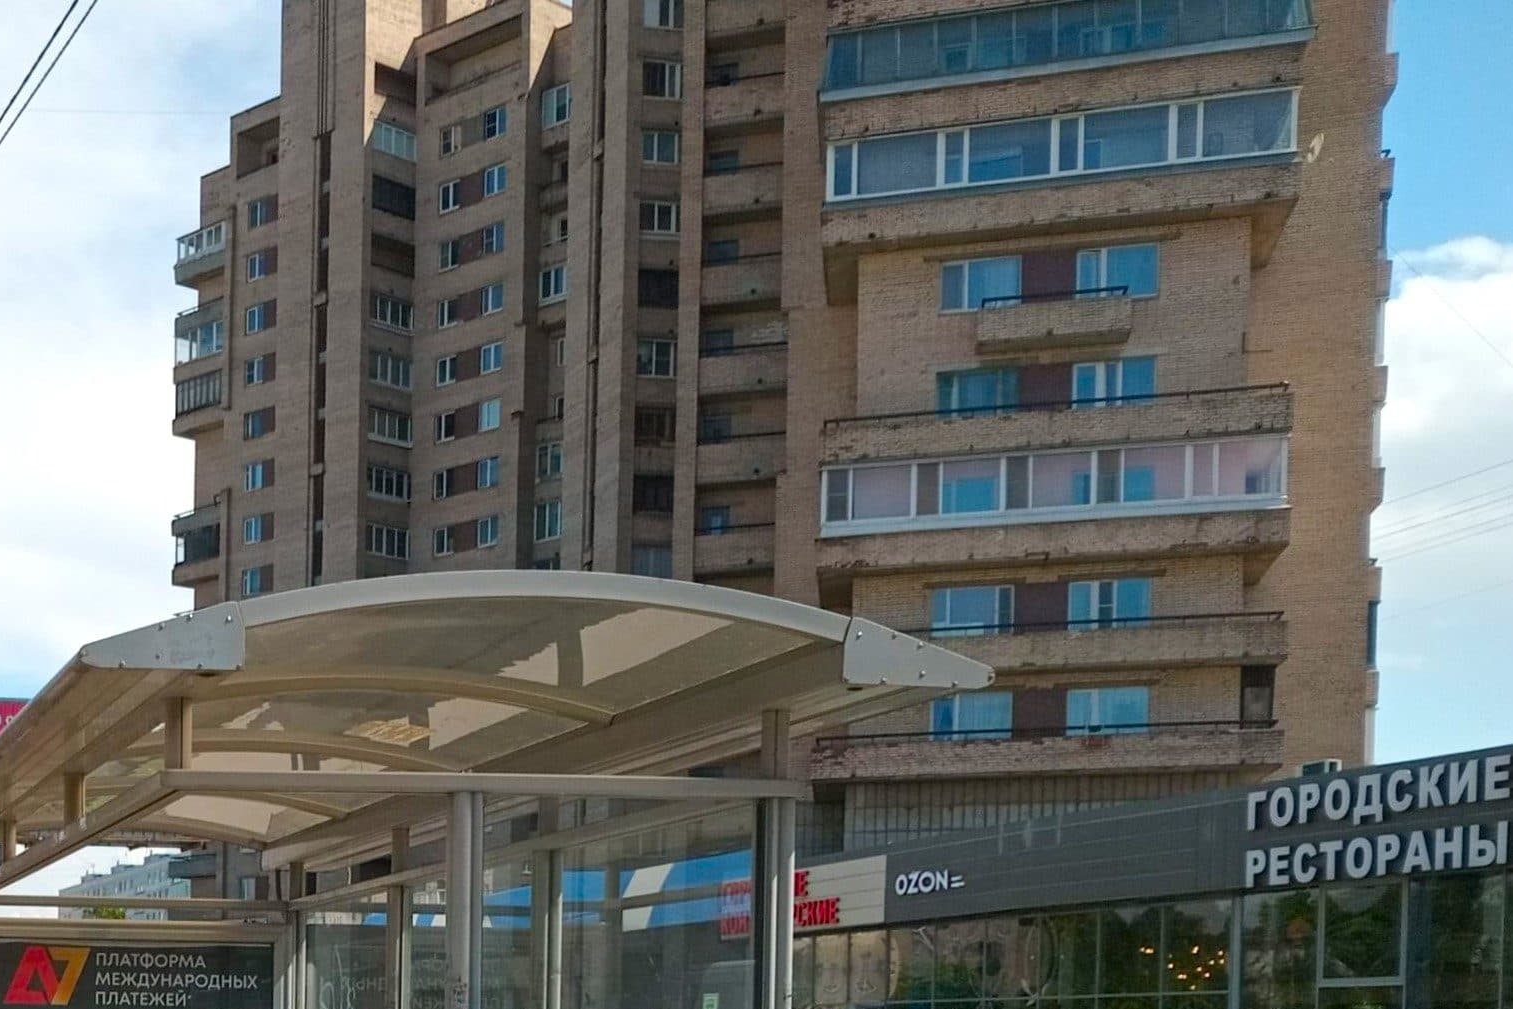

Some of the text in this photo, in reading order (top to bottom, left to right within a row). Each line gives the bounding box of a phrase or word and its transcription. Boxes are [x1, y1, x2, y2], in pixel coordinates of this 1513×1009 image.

[1247, 754, 1512, 831] ГОРОДСКИЕ
[1245, 820, 1508, 888] РЕСТОРАНЫ
[895, 869, 948, 896] OZON
[95, 952, 207, 969] ПЛАТФОРМА
[94, 971, 258, 990] МЕЖДУНАРОДНЫХ
